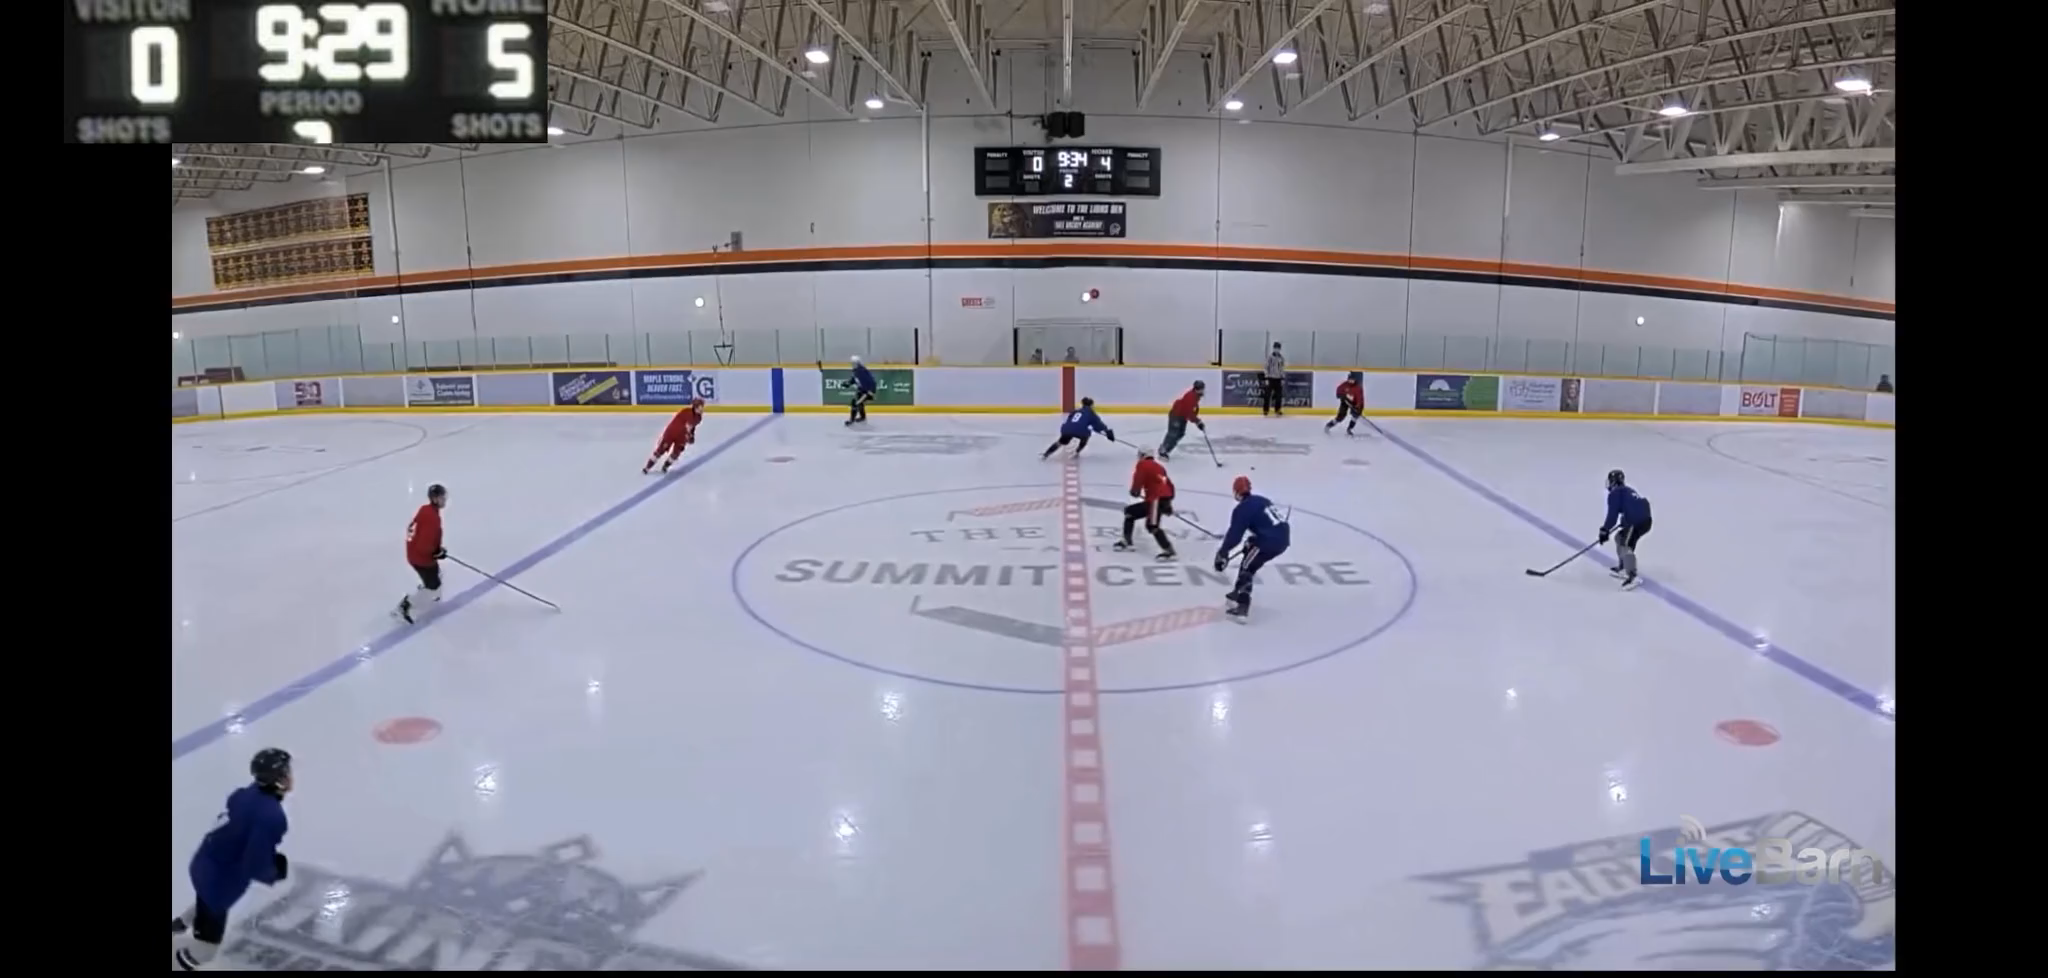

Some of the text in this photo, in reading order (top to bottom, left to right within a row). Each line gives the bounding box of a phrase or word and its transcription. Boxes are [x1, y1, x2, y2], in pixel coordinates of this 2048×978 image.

[1032, 156, 1043, 173] 0
[1058, 151, 1088, 168] 9:34
[1101, 156, 1111, 172] 4
[1064, 174, 1074, 188] 2
[1742, 391, 1778, 408] BOLT
[910, 526, 1046, 543] THE
[774, 558, 1371, 587] SUMMIT CENRE
